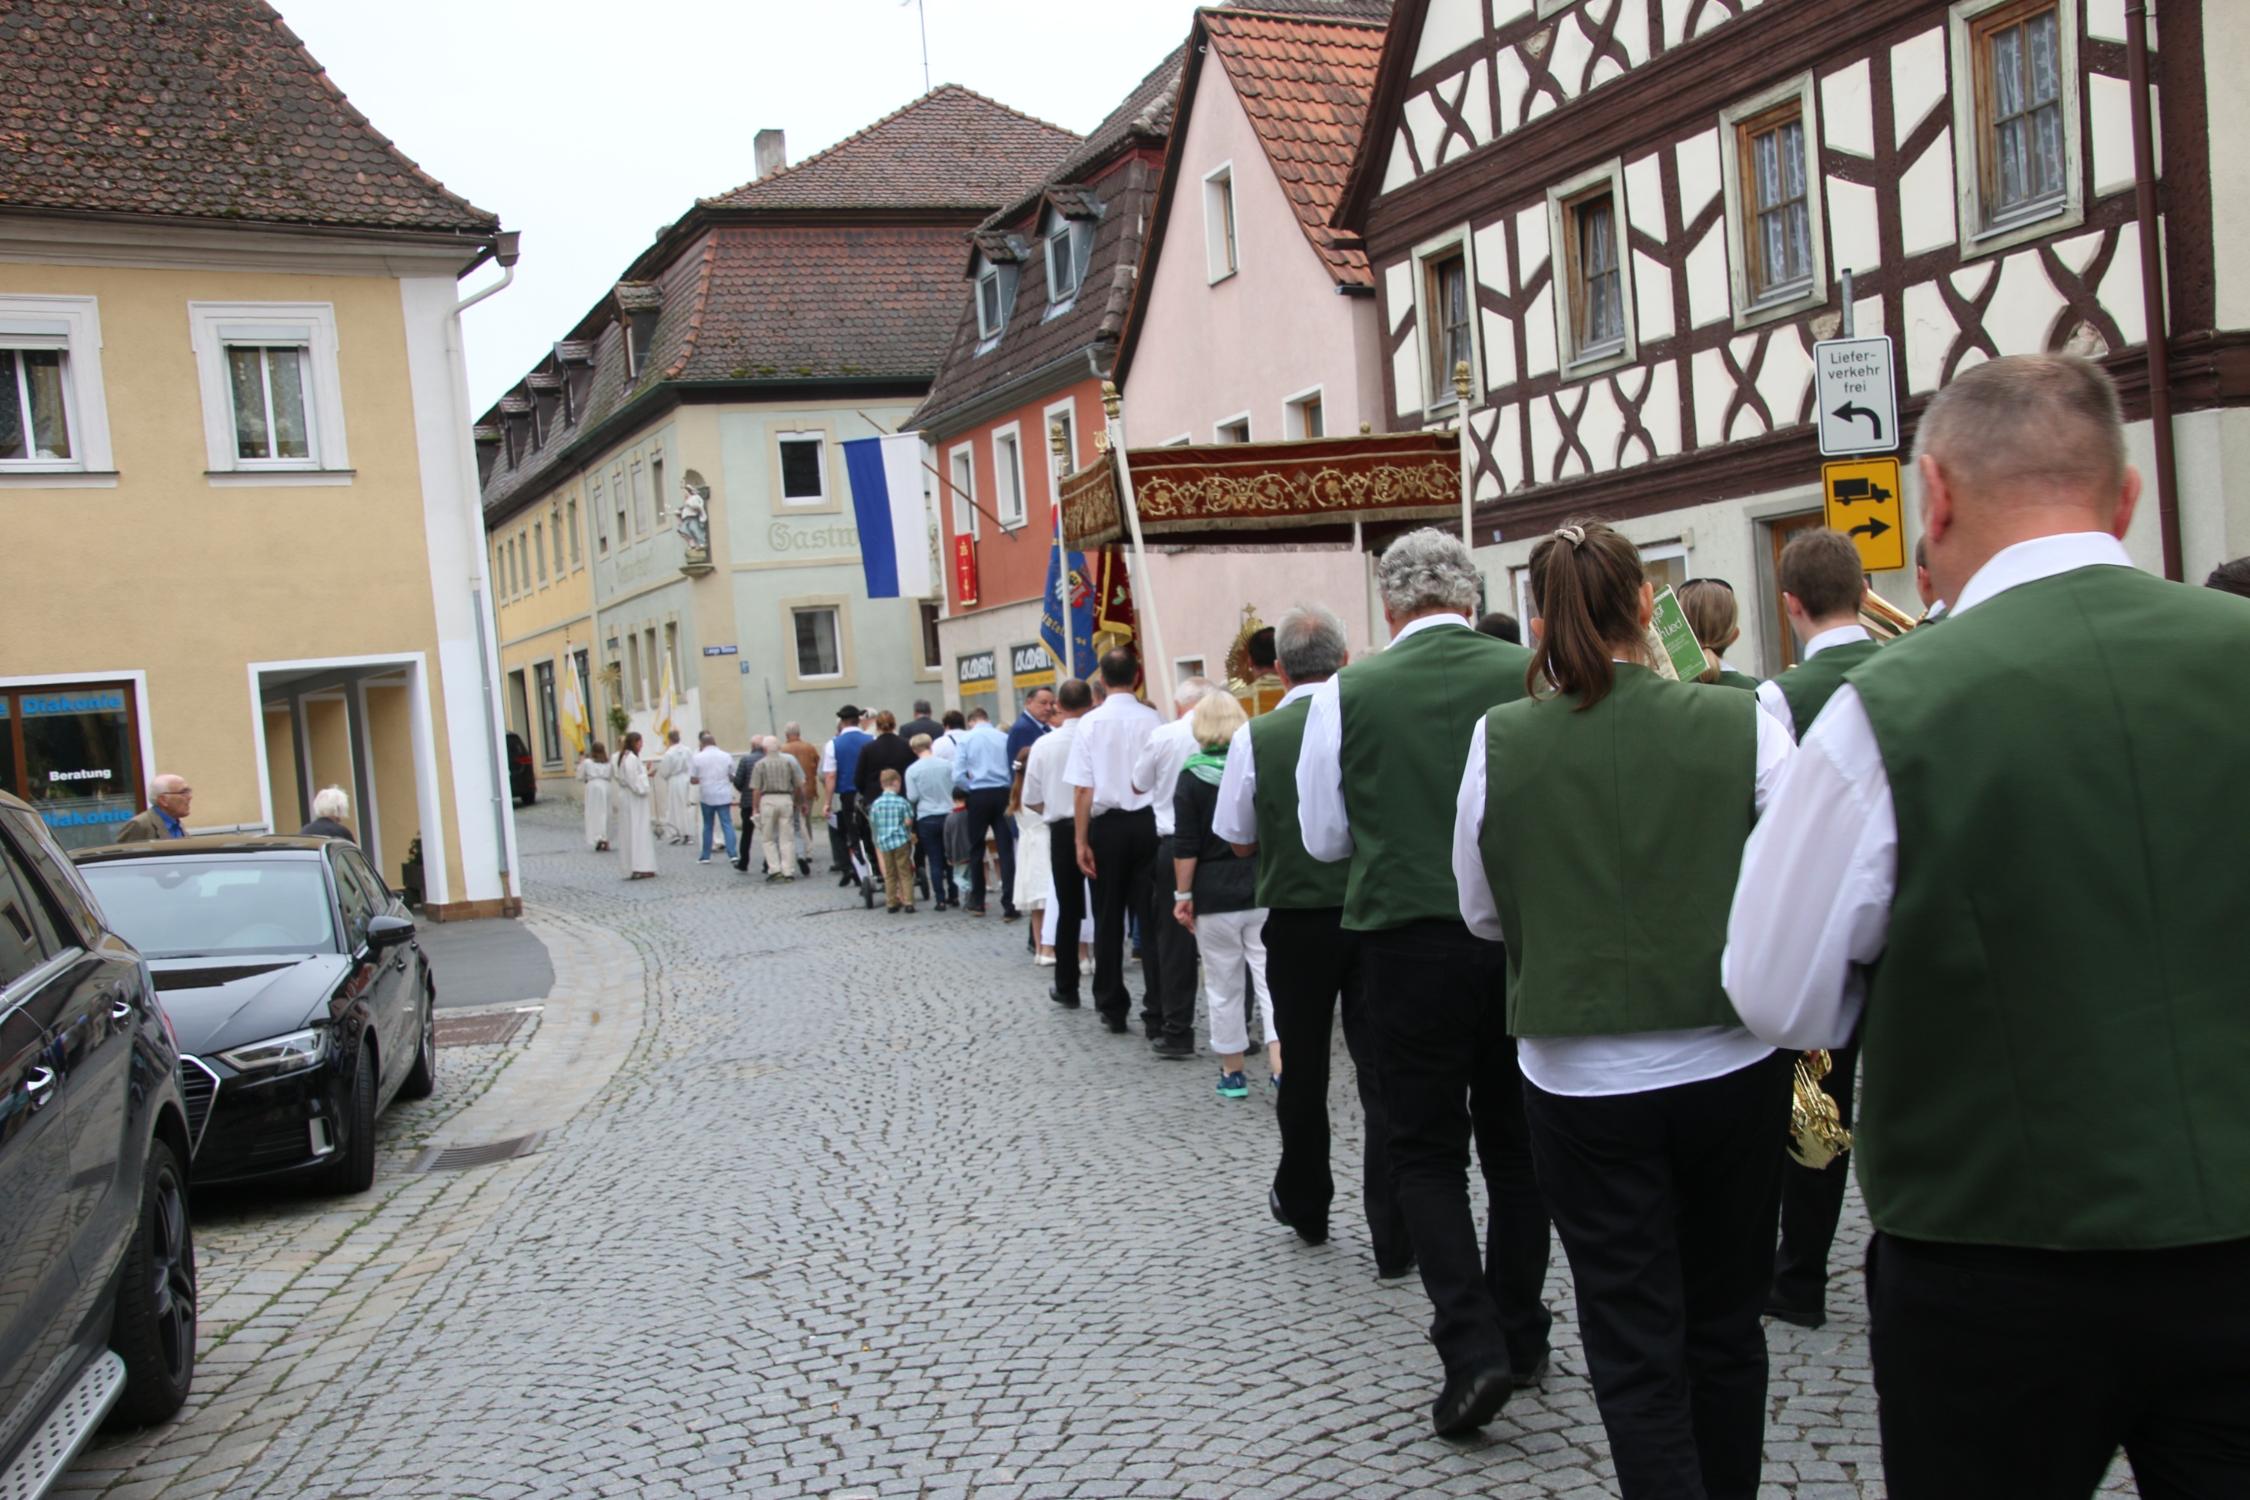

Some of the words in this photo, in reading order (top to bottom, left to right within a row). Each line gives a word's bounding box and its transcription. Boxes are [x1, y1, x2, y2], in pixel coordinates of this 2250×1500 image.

[1830, 350, 1877, 365] Liefer-
[1828, 364, 1880, 379] verkehr
[1844, 381, 1867, 393] frei
[24, 694, 121, 714] Diakonie
[49, 768, 112, 782] Beratung
